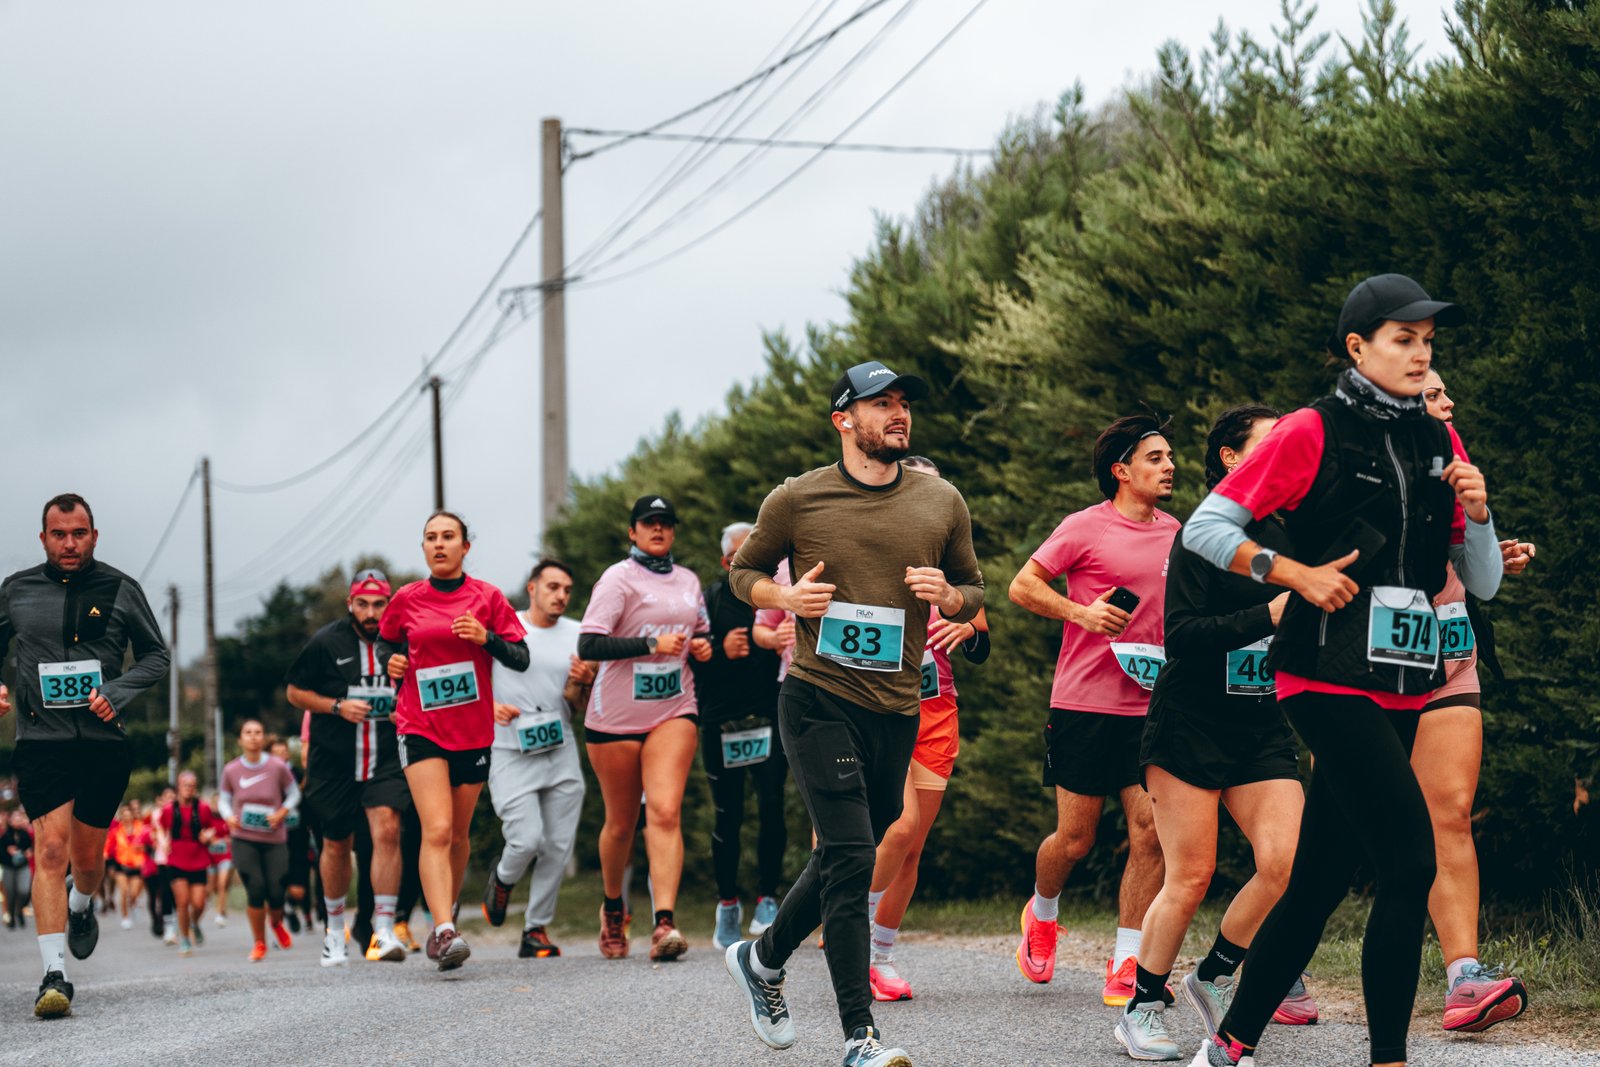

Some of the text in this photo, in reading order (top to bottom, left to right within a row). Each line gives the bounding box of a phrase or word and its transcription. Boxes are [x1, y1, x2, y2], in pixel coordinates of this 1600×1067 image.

[840, 624, 882, 656] 83
[1391, 611, 1432, 651] 574
[1440, 620, 1468, 650] 467
[48, 675, 93, 699] 388
[427, 675, 470, 700] 194
[640, 672, 677, 694] 300
[525, 722, 559, 747] 506
[730, 739, 764, 759] 507
